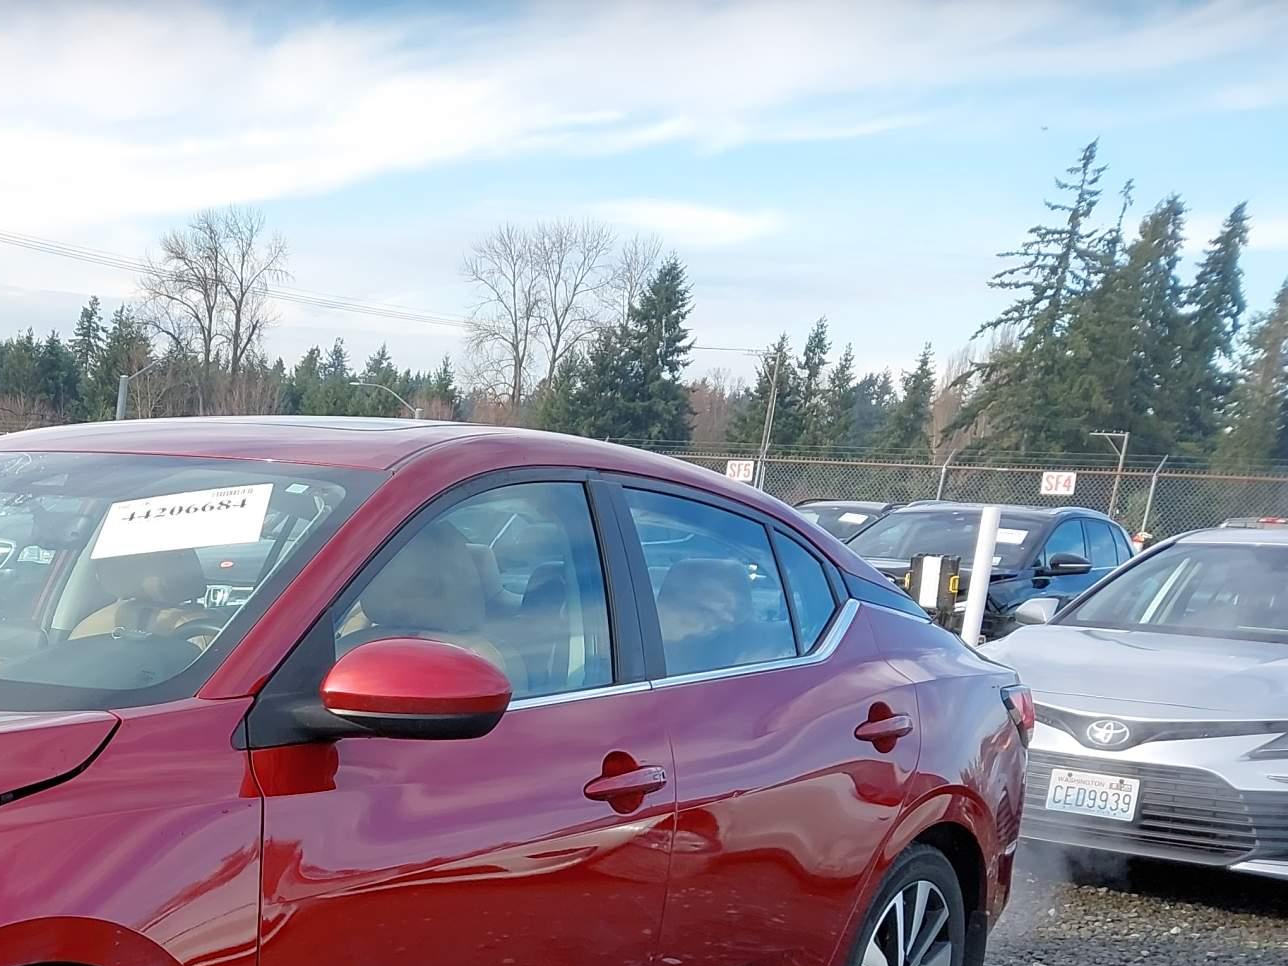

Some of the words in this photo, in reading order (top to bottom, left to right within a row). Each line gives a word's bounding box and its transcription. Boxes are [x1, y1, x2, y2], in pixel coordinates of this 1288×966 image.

[728, 462, 752, 479] SF5
[1044, 474, 1073, 492] SF4
[121, 498, 248, 522] 44206684
[1057, 775, 1106, 789] WASHINGTON
[1052, 784, 1133, 814] CED9939
